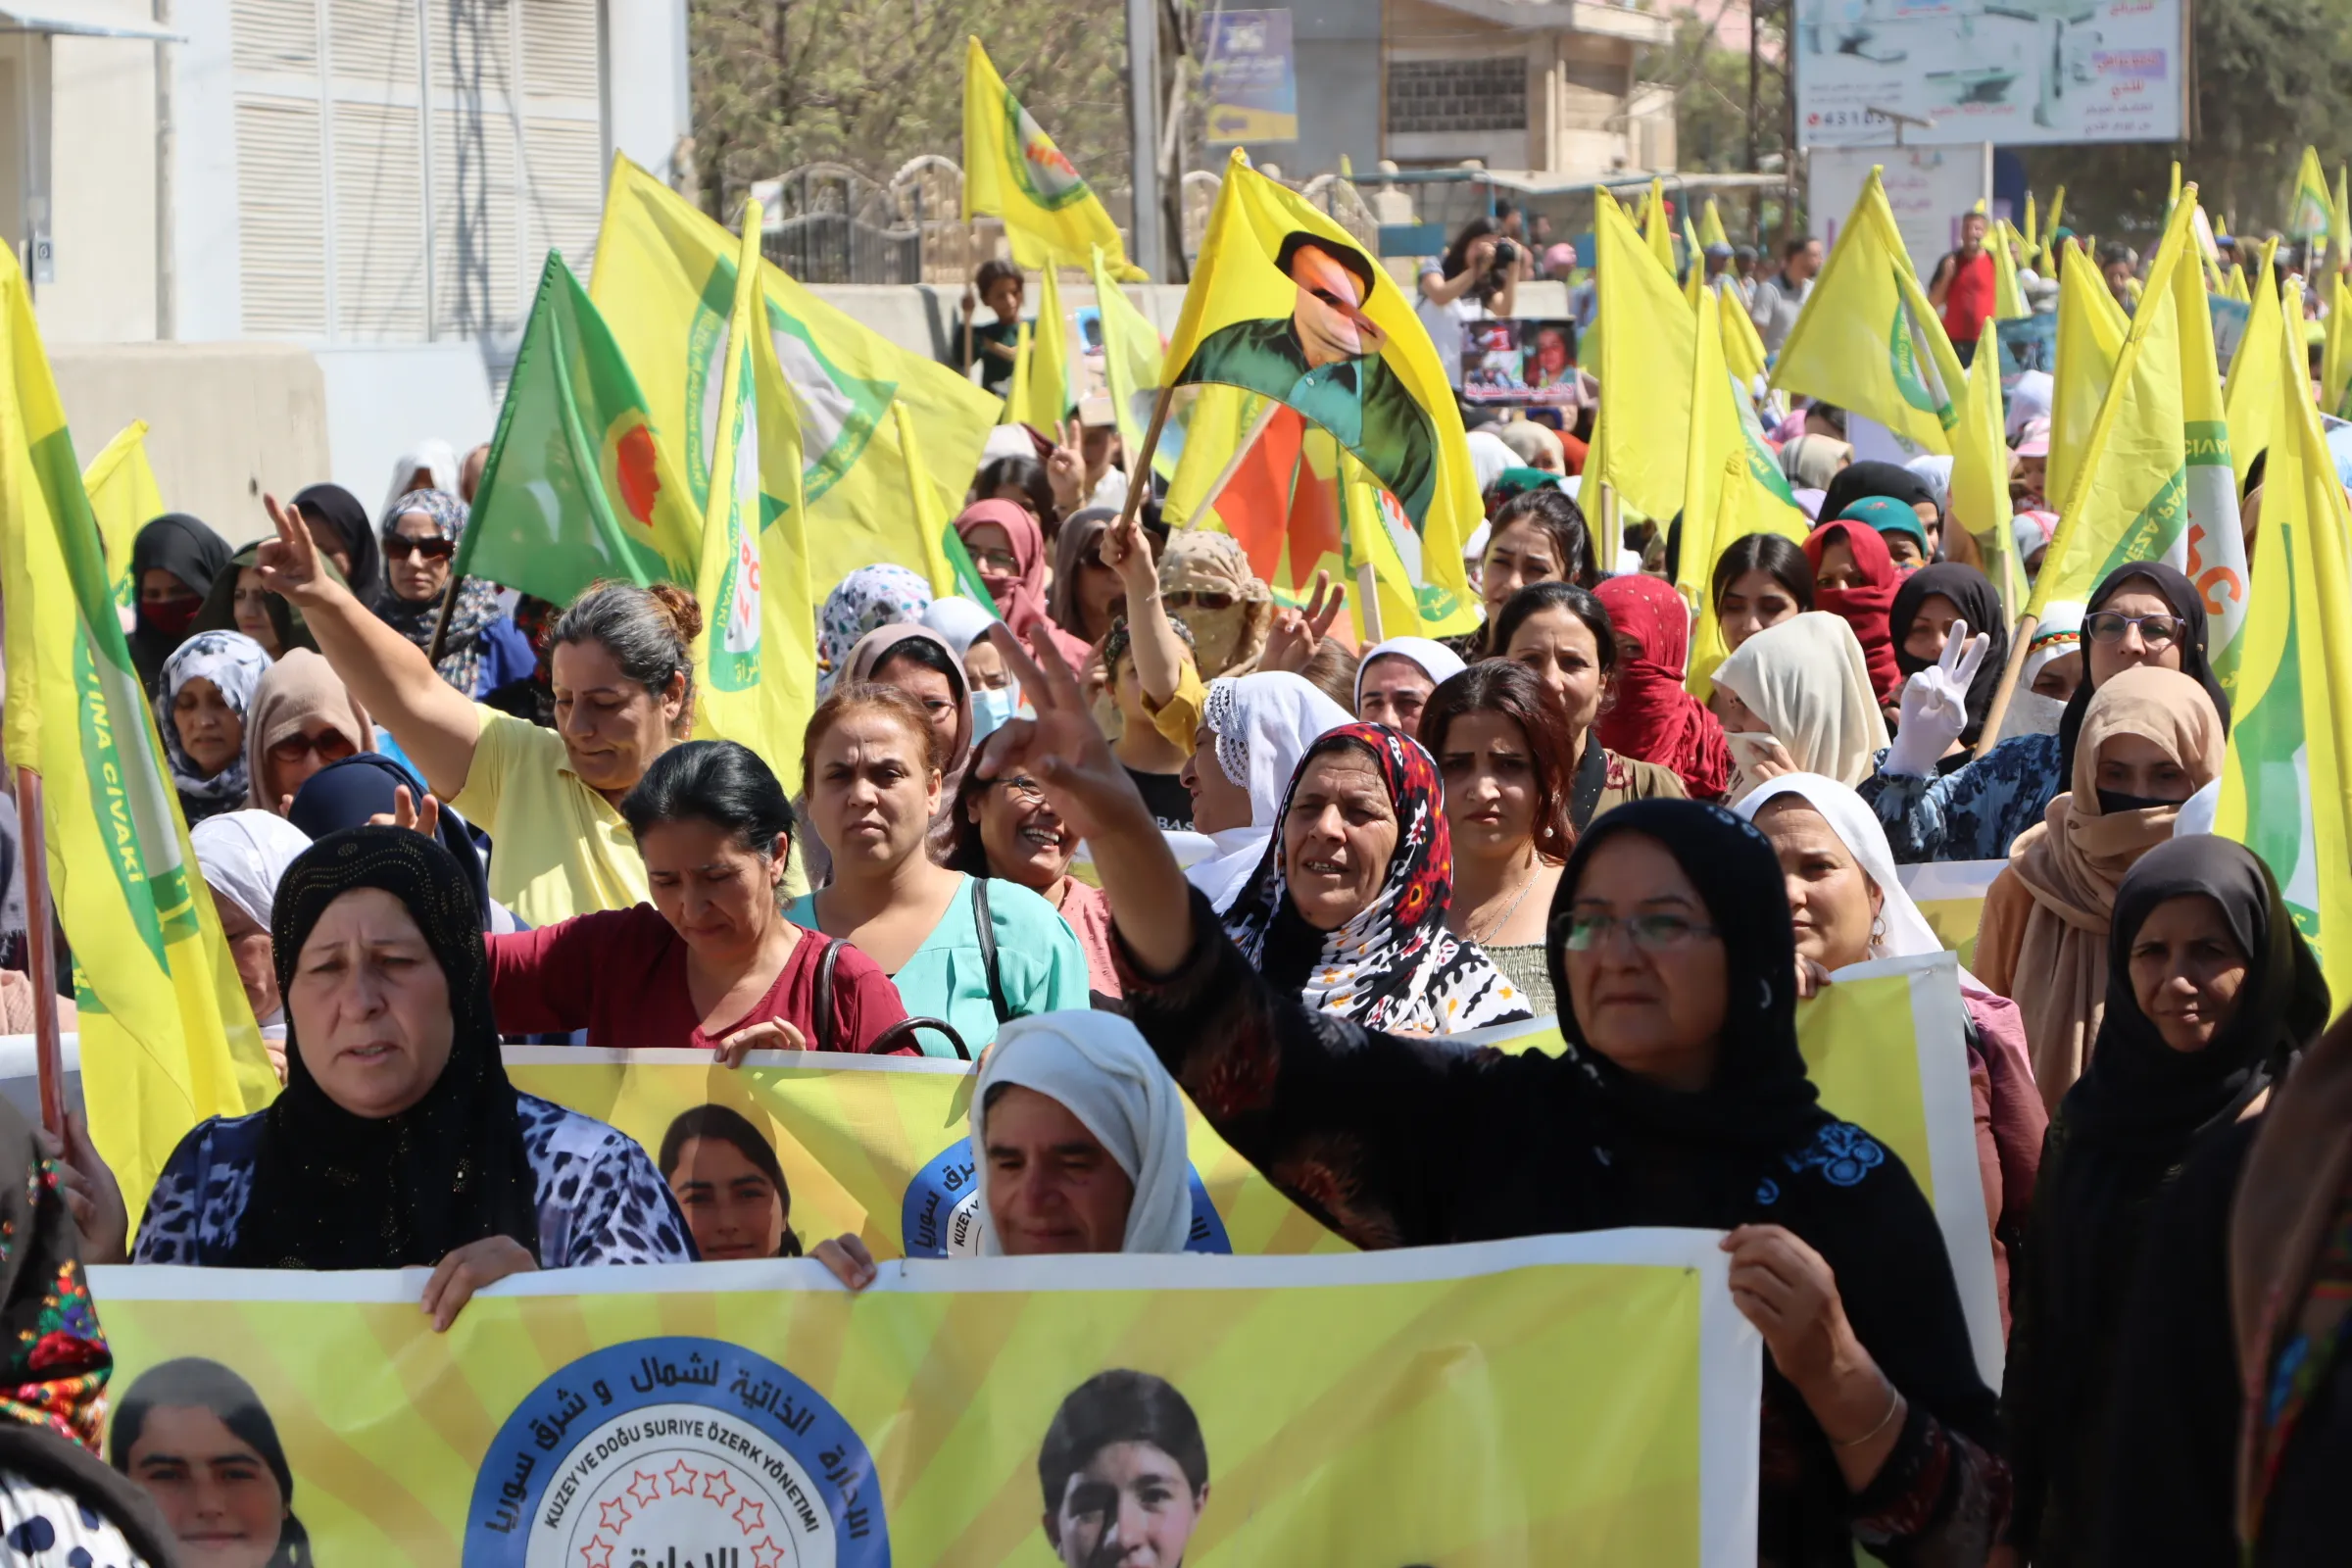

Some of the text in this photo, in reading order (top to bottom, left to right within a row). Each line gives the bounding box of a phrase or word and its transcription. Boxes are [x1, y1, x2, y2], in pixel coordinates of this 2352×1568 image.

[954, 1207, 973, 1248] KUZEY
[630, 1351, 719, 1393] لشمال
[729, 1369, 815, 1438] الذاتية
[528, 1387, 588, 1451] شرق
[484, 1451, 536, 1534] سوريا
[544, 1471, 580, 1530] KUZEY
[574, 1452, 599, 1476] VE
[595, 1425, 641, 1461] DOĞU
[708, 1422, 763, 1464] ÖZERK
